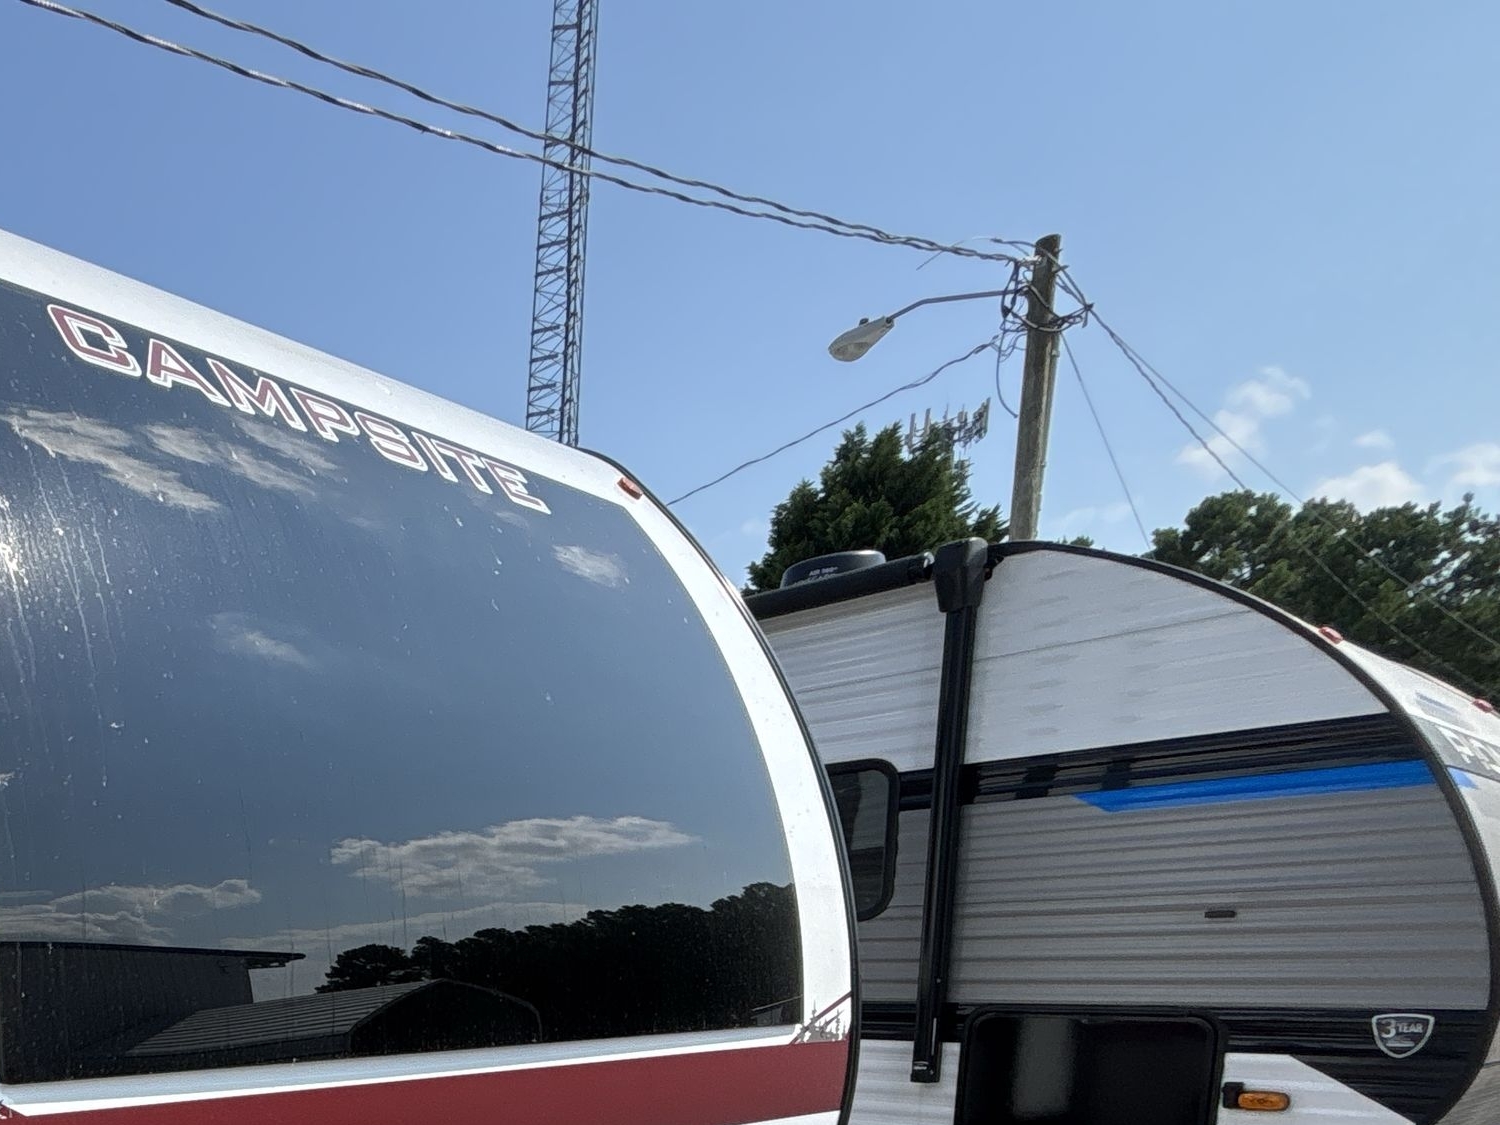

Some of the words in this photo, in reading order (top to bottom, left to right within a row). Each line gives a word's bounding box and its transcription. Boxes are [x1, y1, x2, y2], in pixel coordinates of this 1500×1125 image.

[46, 303, 552, 515] CAMPSITE
[1379, 1018, 1396, 1038] 3
[1396, 1022, 1423, 1033] YEAR
